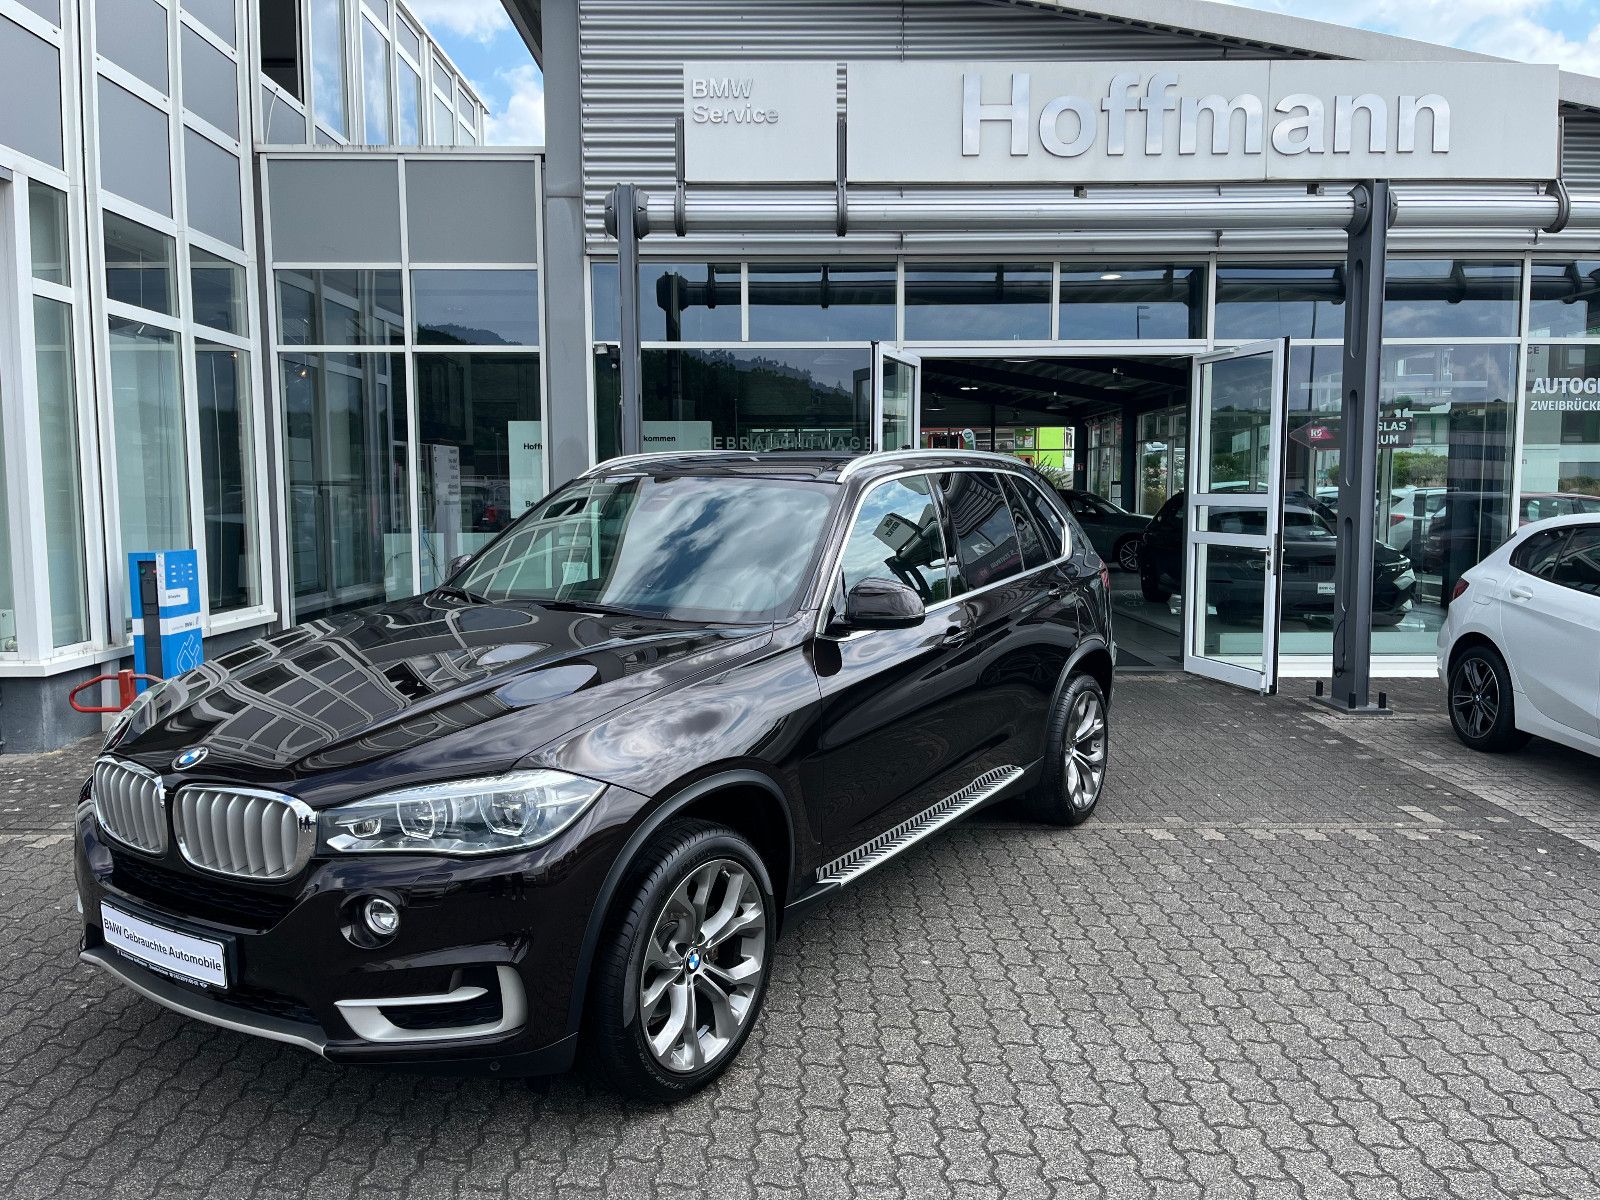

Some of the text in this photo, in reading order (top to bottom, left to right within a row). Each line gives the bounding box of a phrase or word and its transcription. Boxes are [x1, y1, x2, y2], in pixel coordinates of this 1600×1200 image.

[692, 77, 753, 99] BMW
[692, 103, 779, 124] Service
[961, 72, 1451, 157] Hoffmann
[104, 918, 122, 936] BMW
[123, 928, 168, 955] Gebrauchte
[168, 946, 222, 971] Automobile
